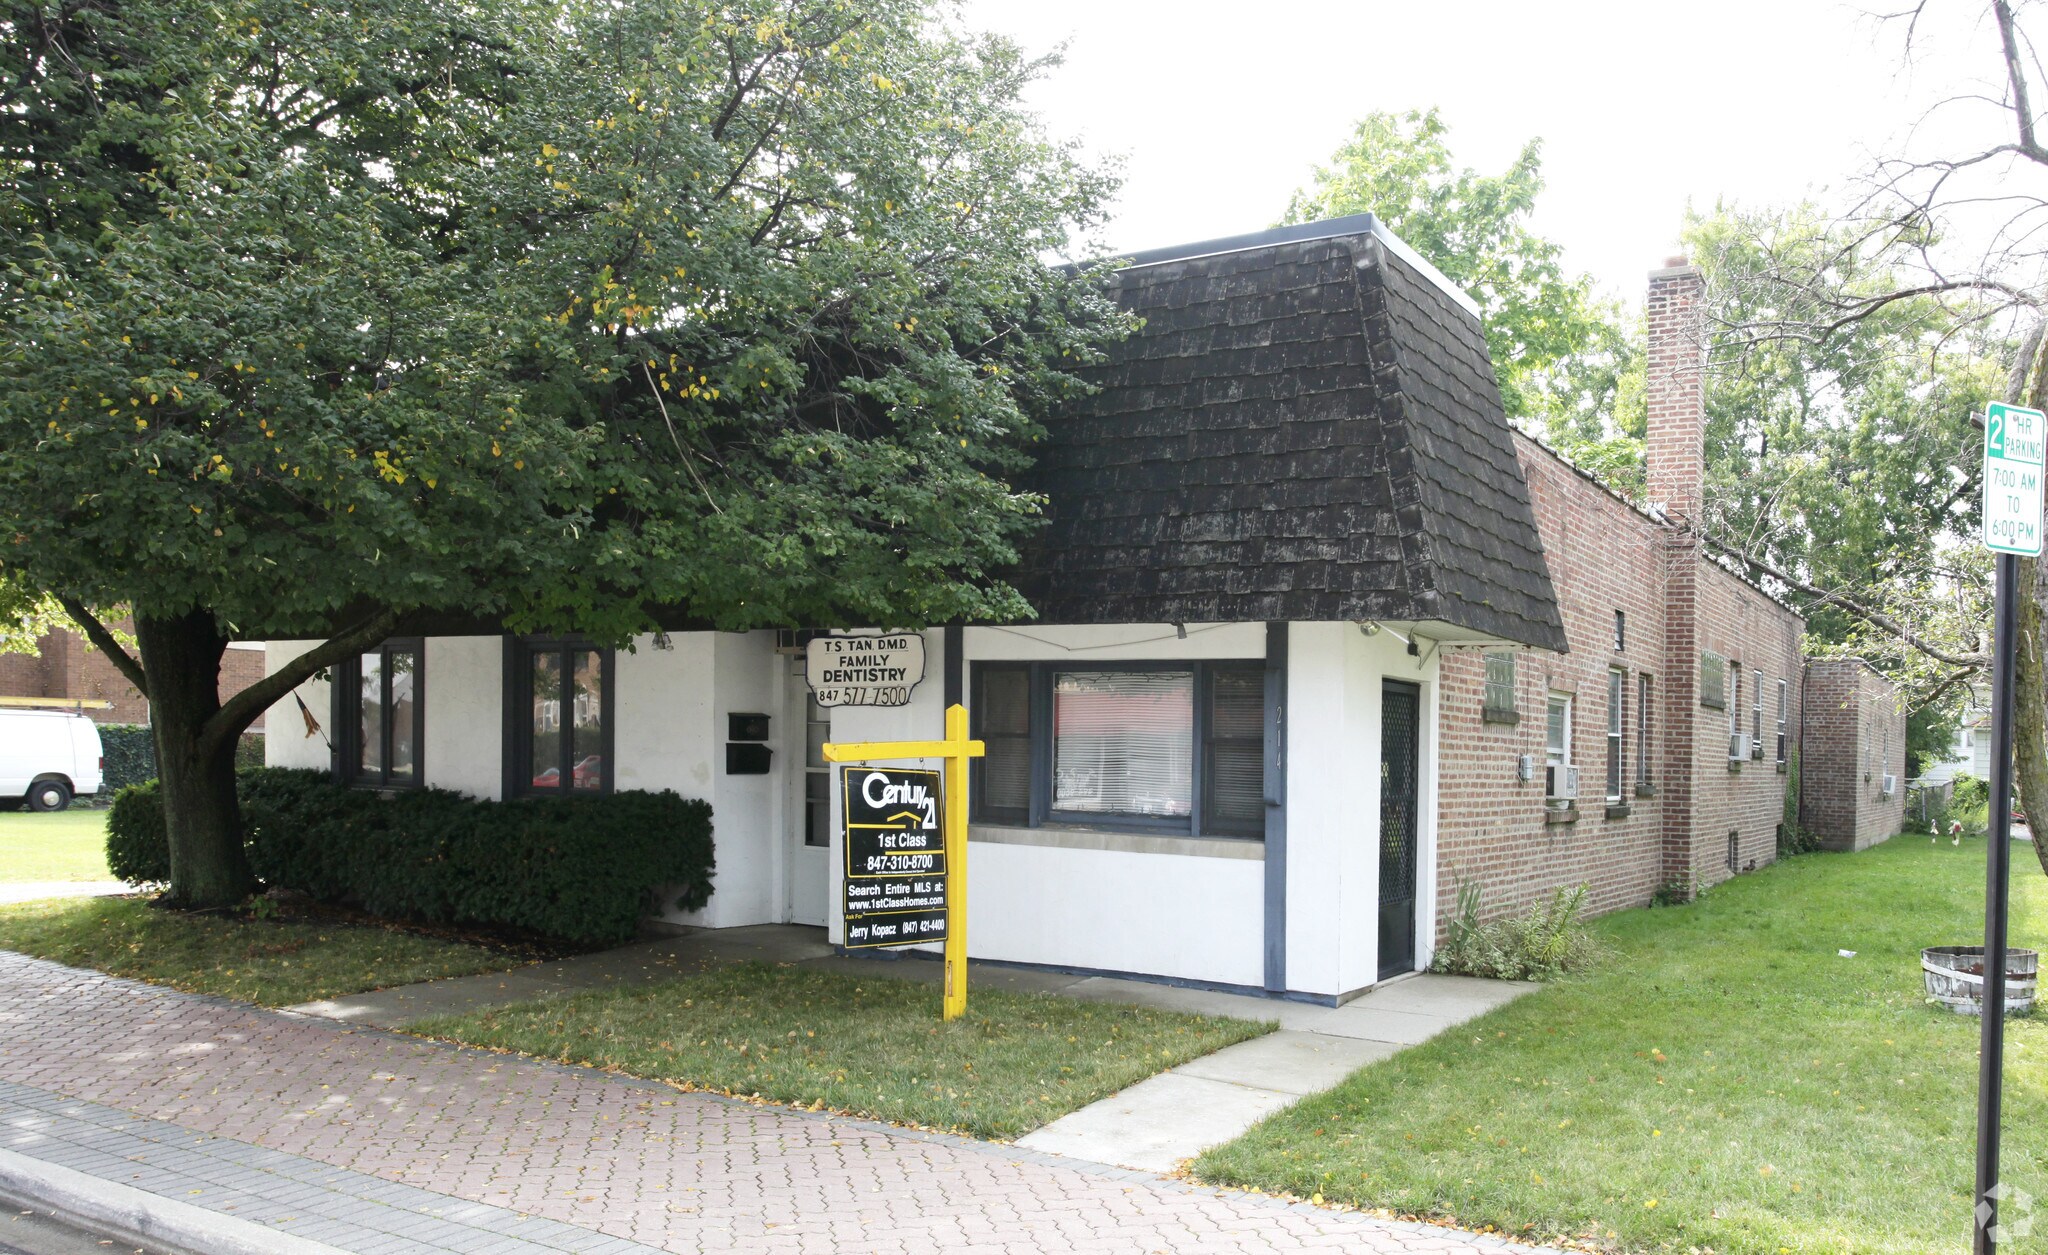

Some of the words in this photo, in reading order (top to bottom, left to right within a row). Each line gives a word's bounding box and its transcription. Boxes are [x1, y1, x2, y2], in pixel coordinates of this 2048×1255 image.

[1990, 414, 2003, 450] 2
[2017, 417, 2032, 435] HR
[2005, 437, 2041, 459] PARKING
[1993, 468, 2016, 488] 7:00
[2020, 473, 2036, 491] AM
[2007, 495, 2020, 513] TO
[1992, 519, 2015, 538] 6:00
[2018, 522, 2034, 541] PM
[839, 654, 890, 667] FAMILY
[823, 668, 907, 683] DENTISTRY
[819, 690, 839, 701] 847
[843, 687, 907, 705] 577-7500
[862, 772, 927, 809] Century
[922, 797, 936, 829] 21
[878, 833, 896, 848] 1st
[899, 832, 927, 847] Class
[867, 855, 933, 870] 847-310-8700
[848, 884, 881, 896] Search
[885, 883, 910, 895] Entire
[914, 882, 931, 893] MLS
[934, 882, 944, 892] at:
[848, 896, 944, 910] www.1stClassHomes.com
[849, 925, 868, 940] Jerry
[871, 924, 896, 938] Kopacz
[902, 921, 918, 934] (847)
[920, 918, 944, 932] 421-4400
